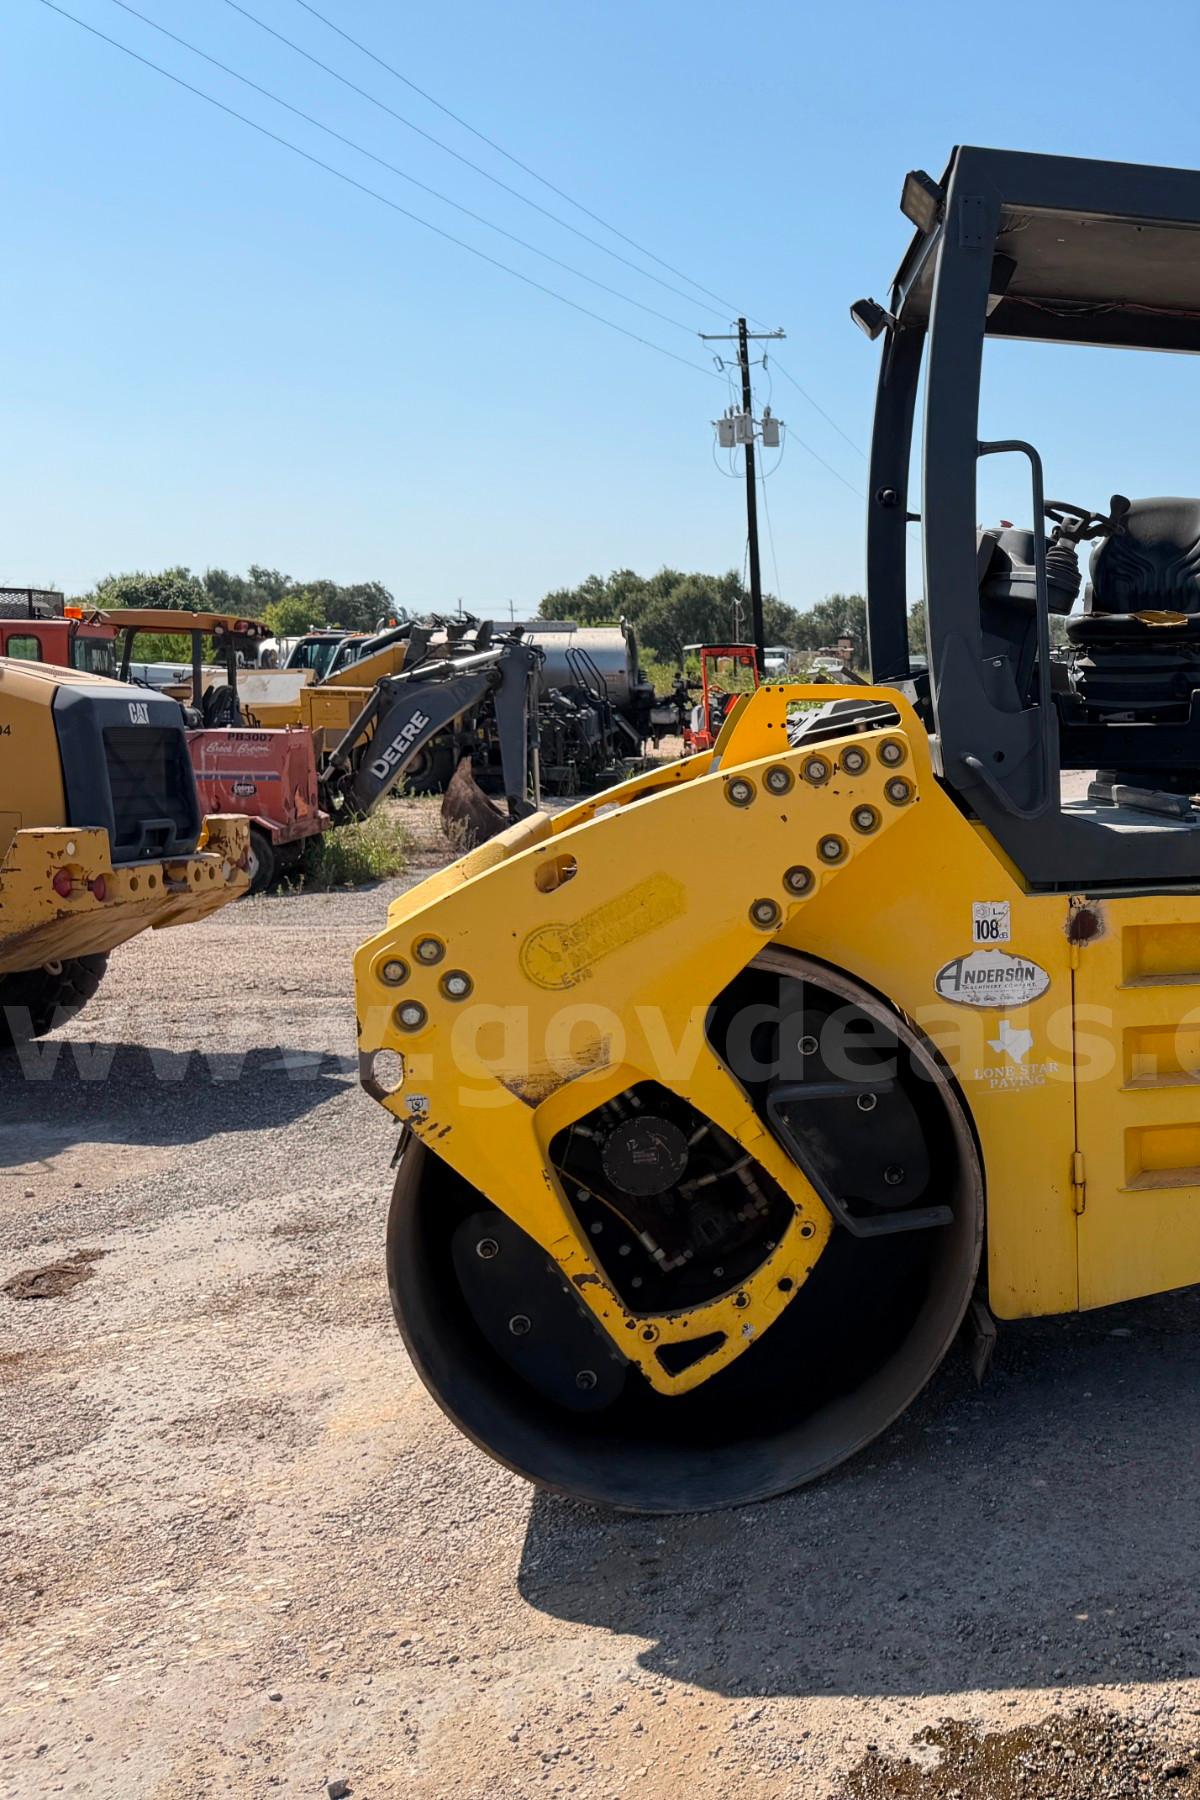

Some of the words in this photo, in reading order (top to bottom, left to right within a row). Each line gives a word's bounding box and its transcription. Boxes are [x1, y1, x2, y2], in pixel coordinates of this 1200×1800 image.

[128, 702, 150, 724] CAT
[227, 732, 274, 742] PB3007
[369, 709, 430, 780] DEERE
[975, 919, 999, 940] 108
[935, 959, 1036, 993] ANDERSON
[974, 1065, 1014, 1080] LONE
[1020, 1062, 1058, 1074] STAR
[990, 1074, 1046, 1089] PAVING
